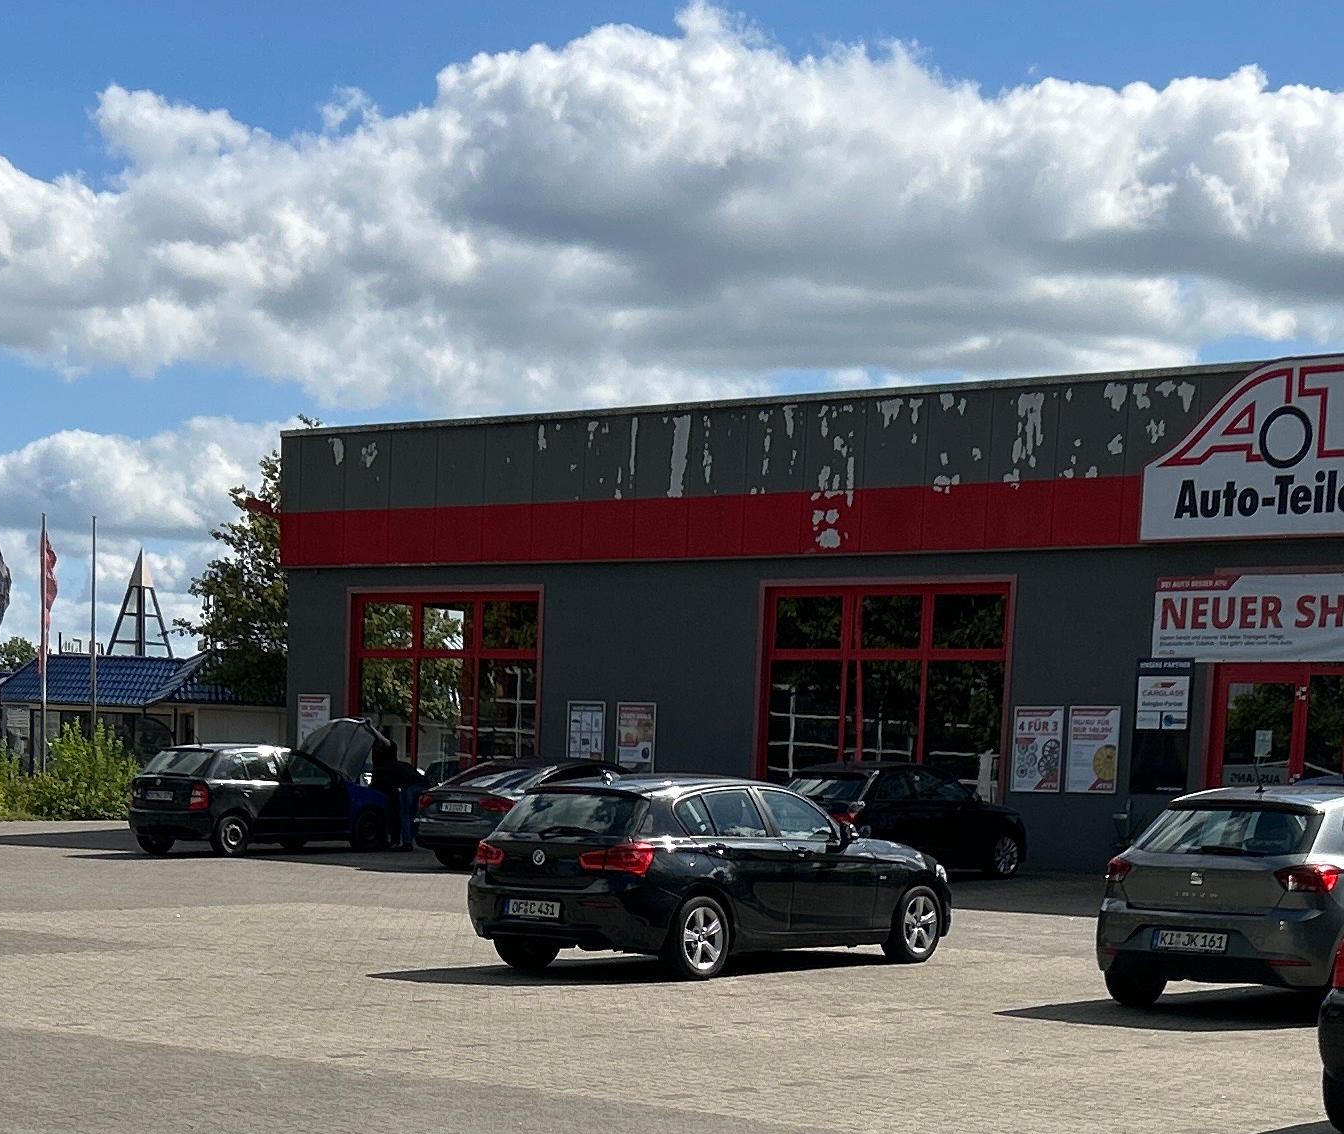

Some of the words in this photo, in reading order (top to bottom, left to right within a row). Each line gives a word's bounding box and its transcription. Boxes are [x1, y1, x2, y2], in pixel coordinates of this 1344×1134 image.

[1160, 595, 1284, 630] NEUER
[1018, 721, 1025, 732] 4
[1028, 719, 1049, 732] FÜR
[1052, 721, 1058, 732] 3
[1159, 933, 1174, 946] KI
[1200, 935, 1224, 949] 161
